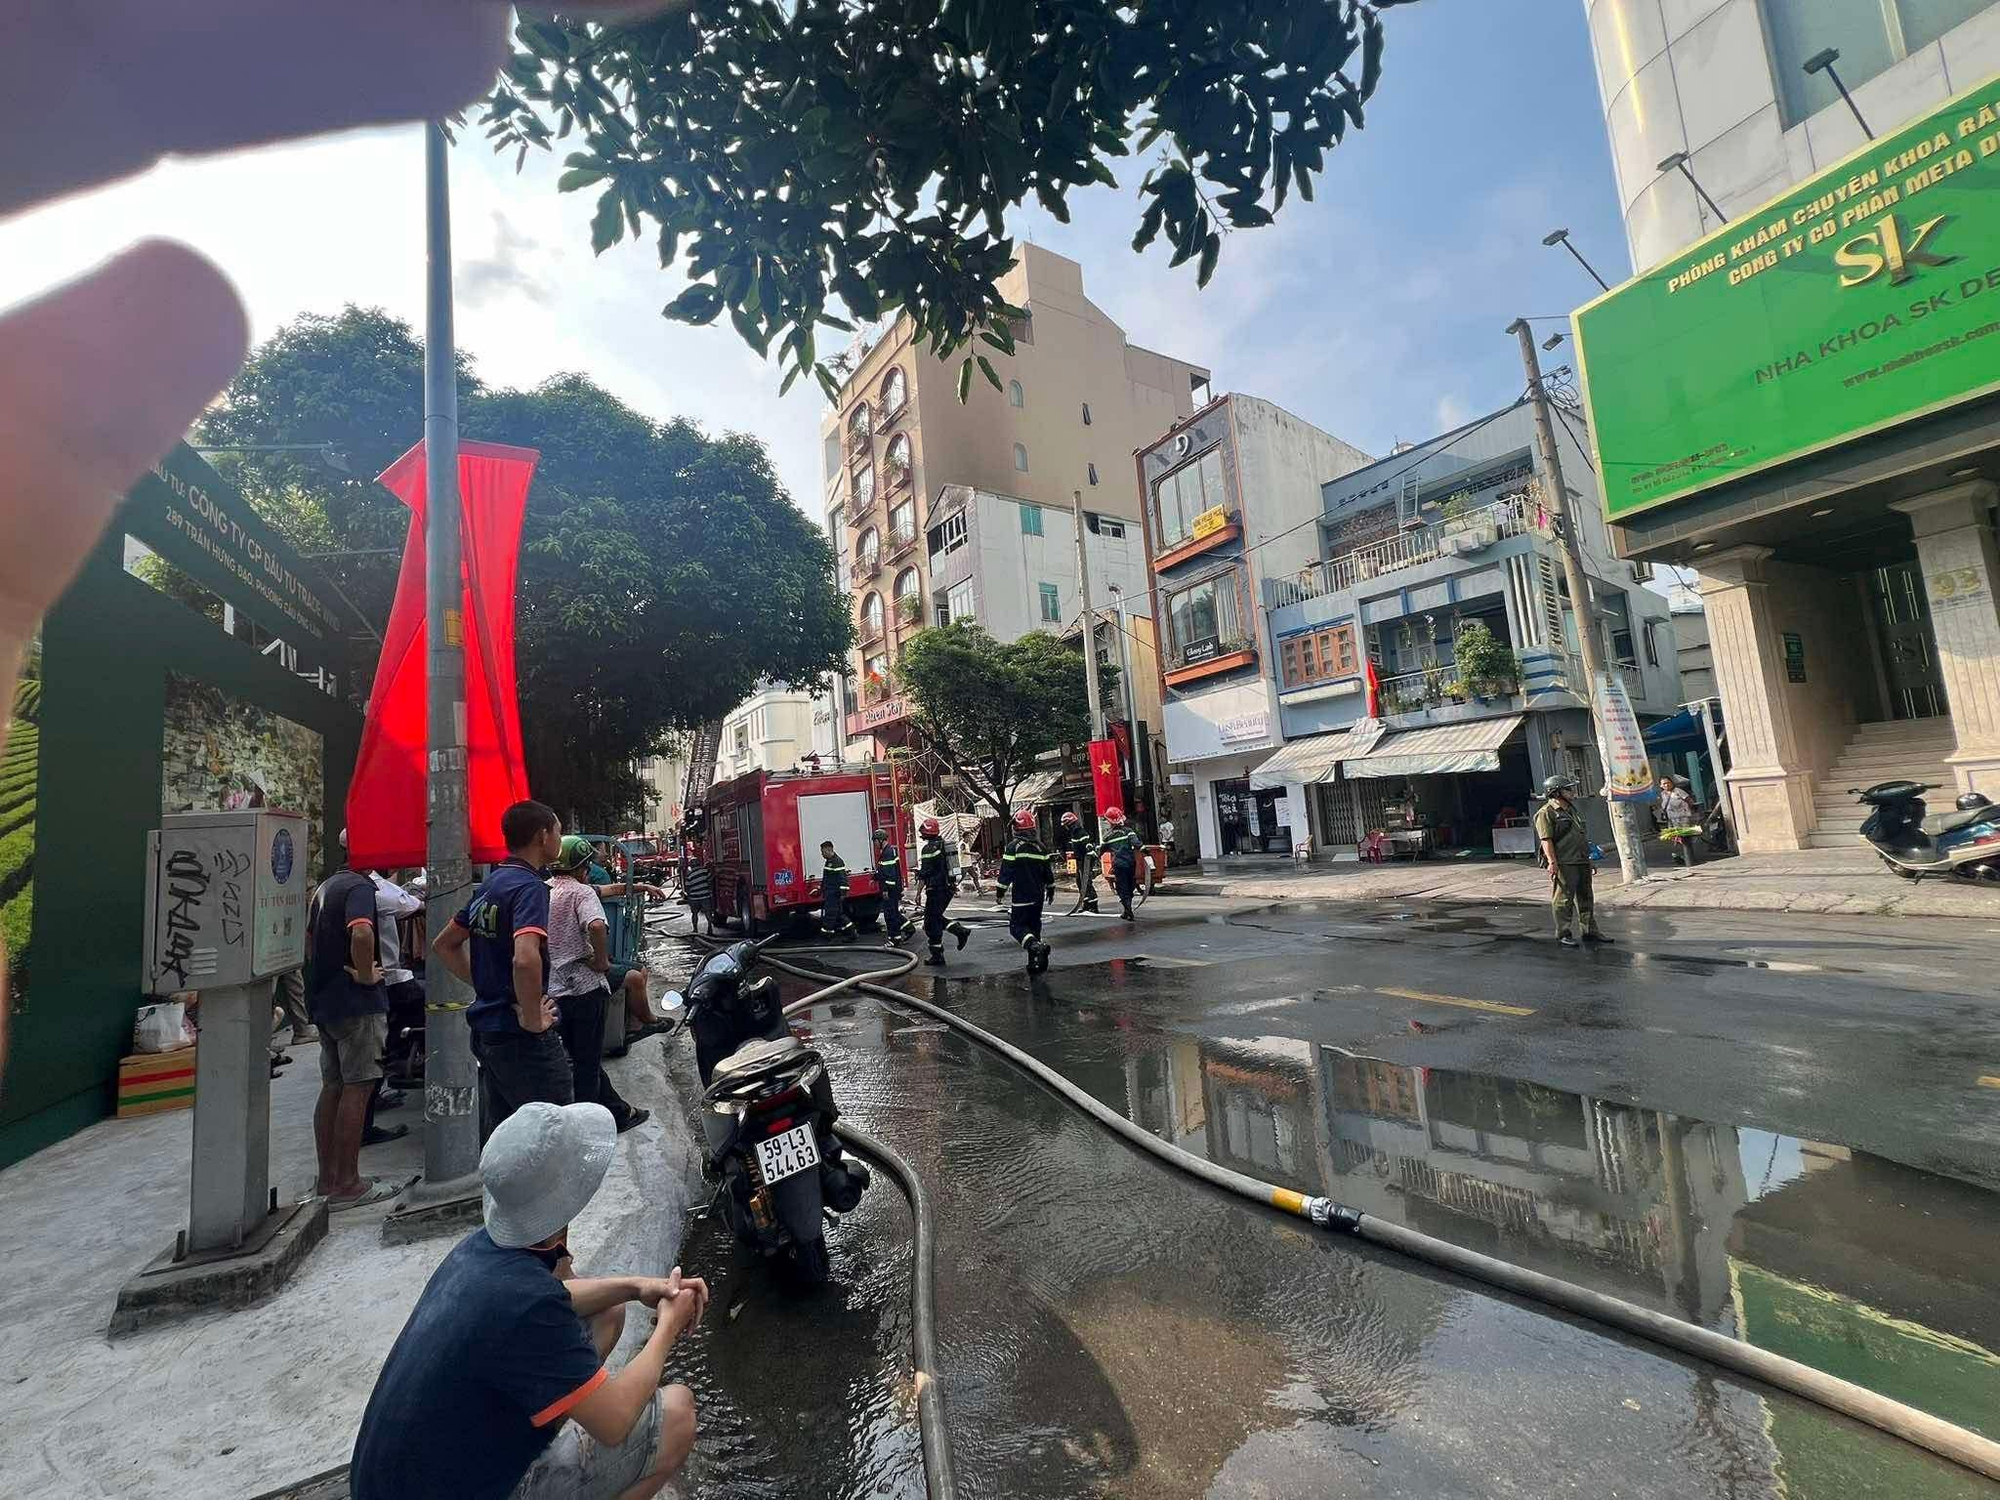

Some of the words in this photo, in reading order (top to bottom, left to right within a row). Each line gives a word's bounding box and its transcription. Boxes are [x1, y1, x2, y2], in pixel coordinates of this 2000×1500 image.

[1905, 149, 1975, 196] META
[1730, 218, 1789, 260] KHÁM
[1792, 167, 1880, 227] CHUYÊN
[1884, 131, 1953, 179] KHOA
[1755, 351, 1813, 384] NHA
[1818, 313, 1903, 359] KHOA
[1908, 289, 1953, 319] SK
[165, 505, 184, 529] 289
[230, 520, 247, 551] TY
[248, 538, 263, 564] CP
[763, 1128, 806, 1160] 59-L3
[765, 1146, 815, 1181] 544.63
